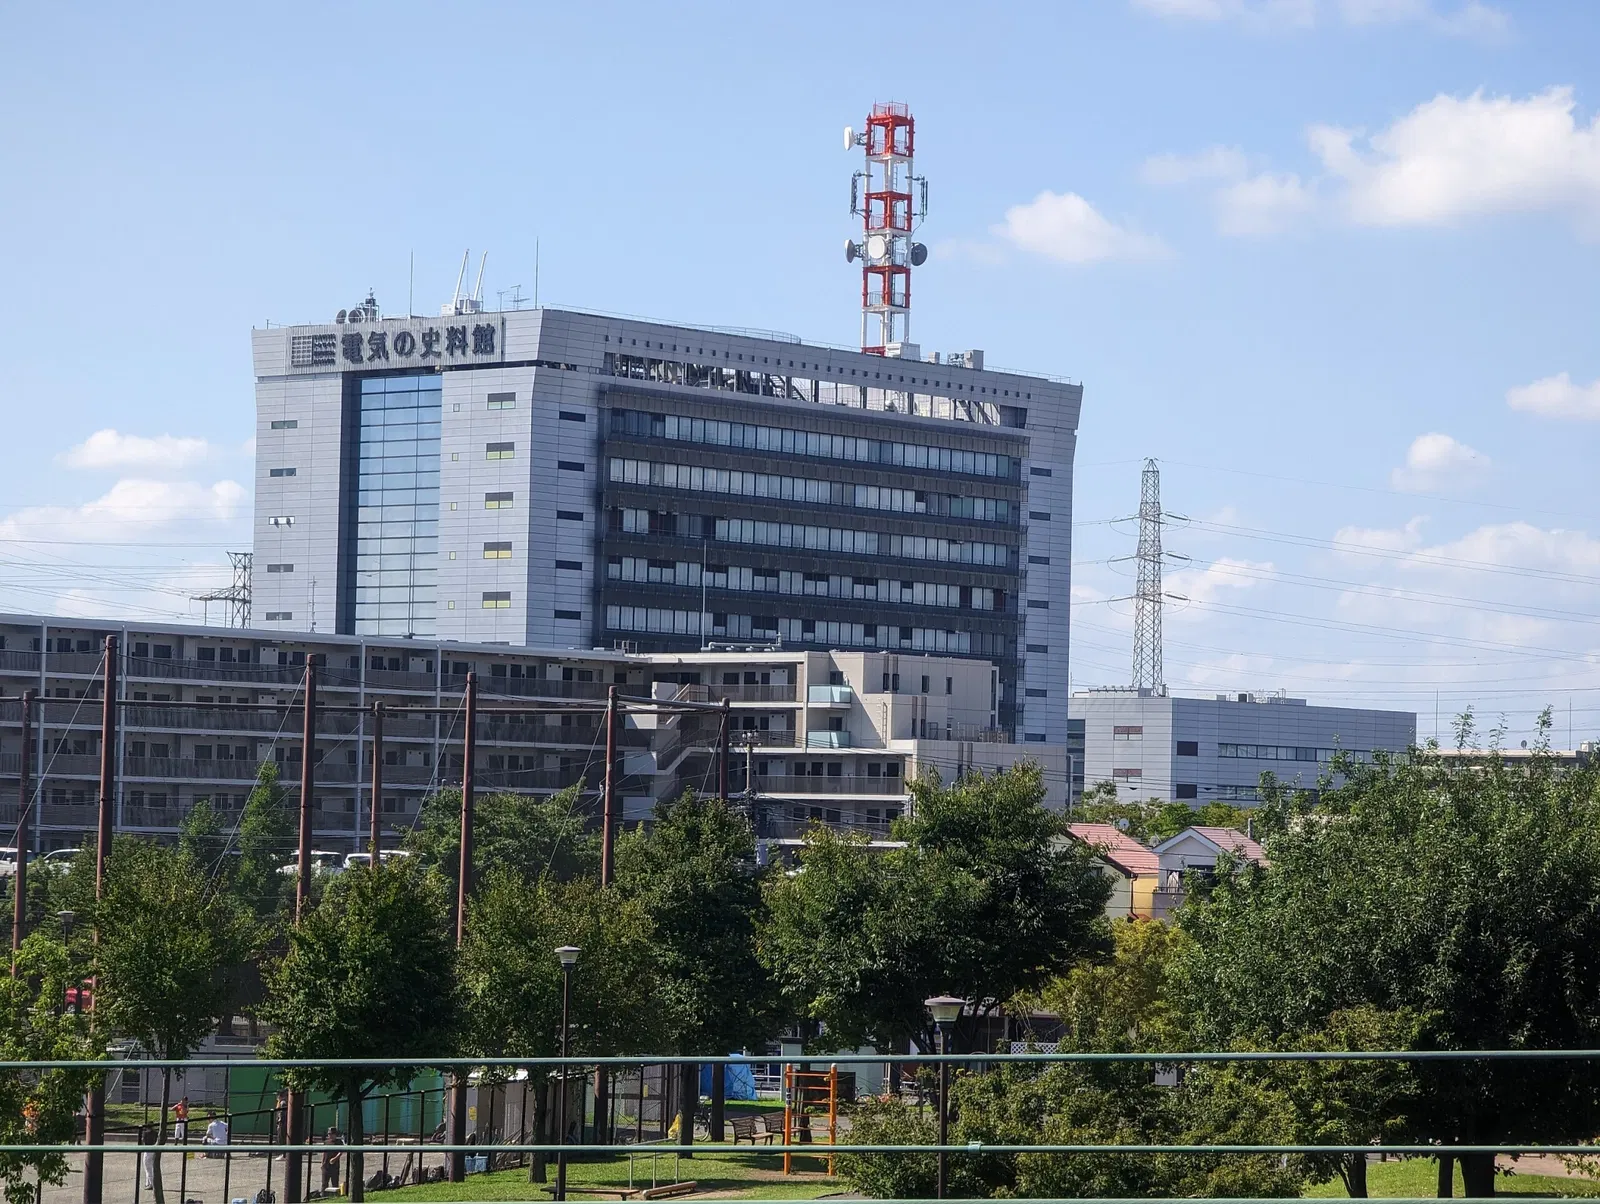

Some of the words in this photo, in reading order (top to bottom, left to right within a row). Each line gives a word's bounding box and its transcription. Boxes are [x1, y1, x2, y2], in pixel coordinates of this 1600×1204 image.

[341, 323, 496, 364] 電気の史料館
